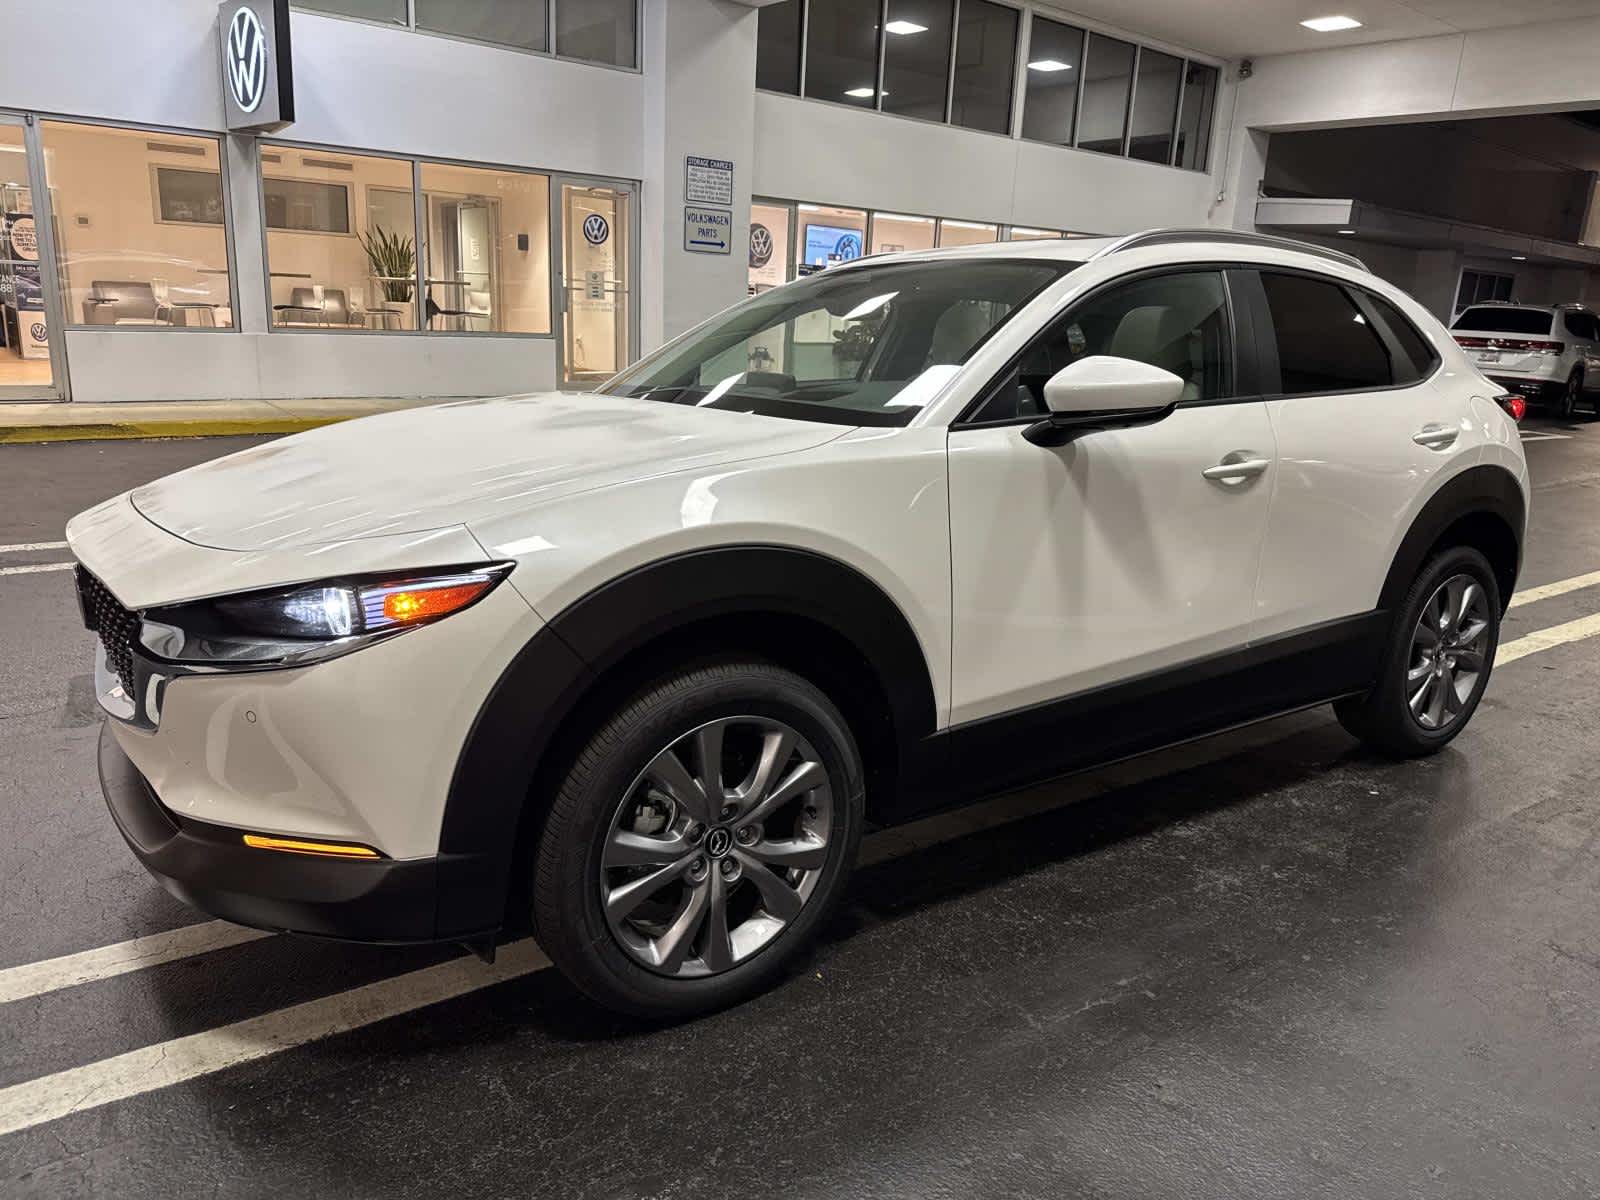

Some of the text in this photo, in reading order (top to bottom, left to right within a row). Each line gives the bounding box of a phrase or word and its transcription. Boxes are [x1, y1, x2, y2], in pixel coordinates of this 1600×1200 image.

[228, 7, 265, 112] VW
[584, 215, 608, 244] VW
[687, 212, 729, 226] VOLKSWAGEN
[697, 227, 718, 239] PARTS
[751, 228, 773, 258] VW
